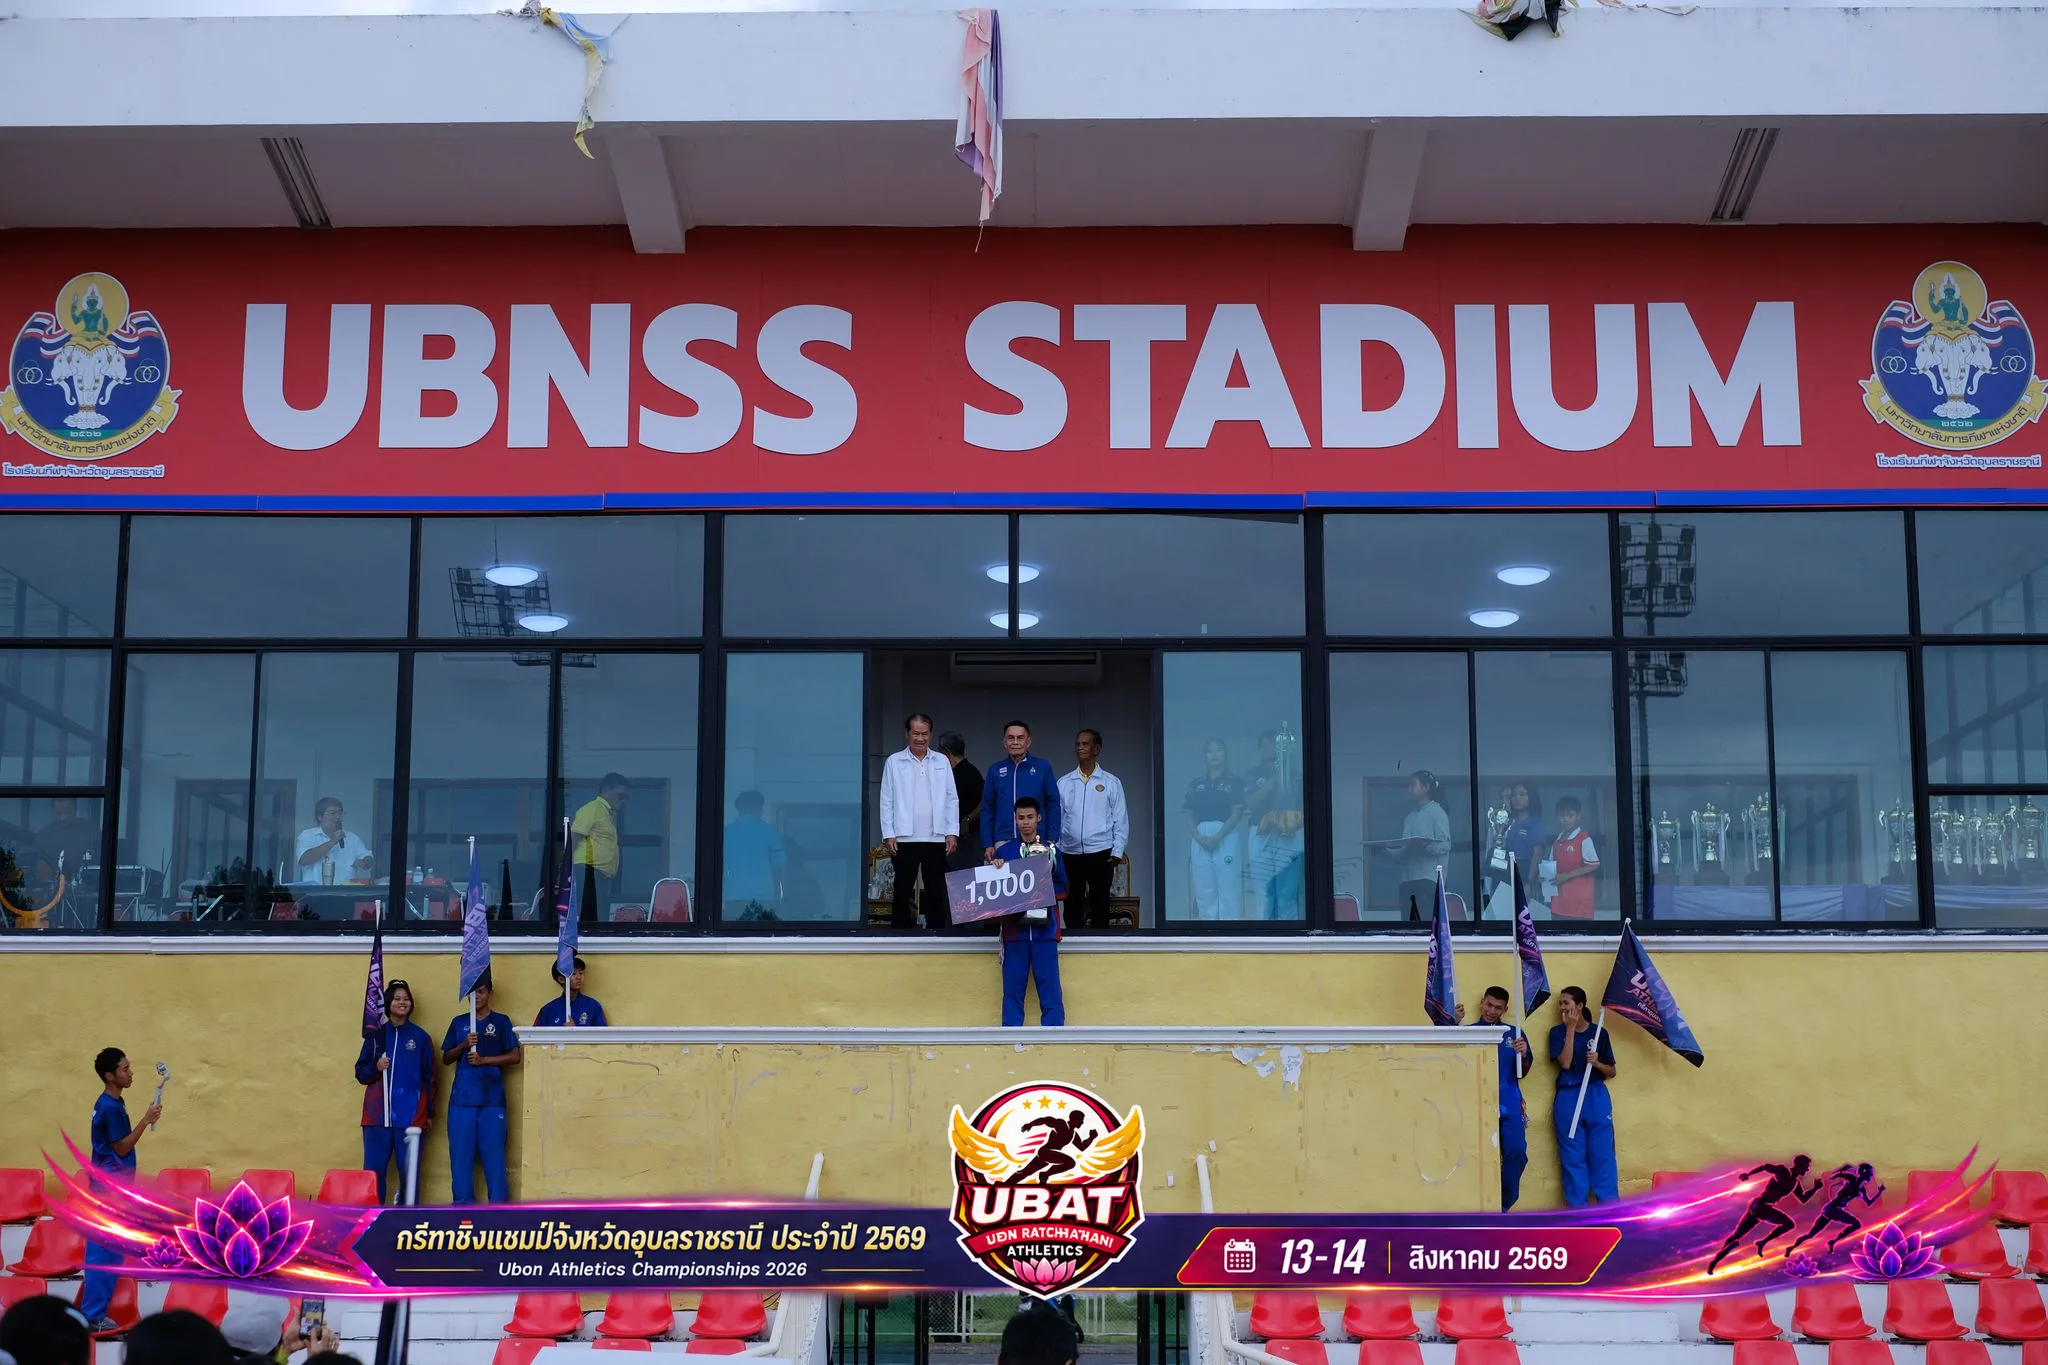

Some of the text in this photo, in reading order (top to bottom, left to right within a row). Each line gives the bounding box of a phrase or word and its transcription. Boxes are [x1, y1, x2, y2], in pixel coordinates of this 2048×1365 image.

[242, 300, 1802, 456] UBNSS STADIUM
[4, 463, 163, 479] โรงเรียนกีฬาจังหวัดอุบลราชธานี
[1877, 454, 2040, 469] โรงเรียนกีฬาจังหวัดอุบลราชธานี
[965, 869, 1035, 906] 1,000
